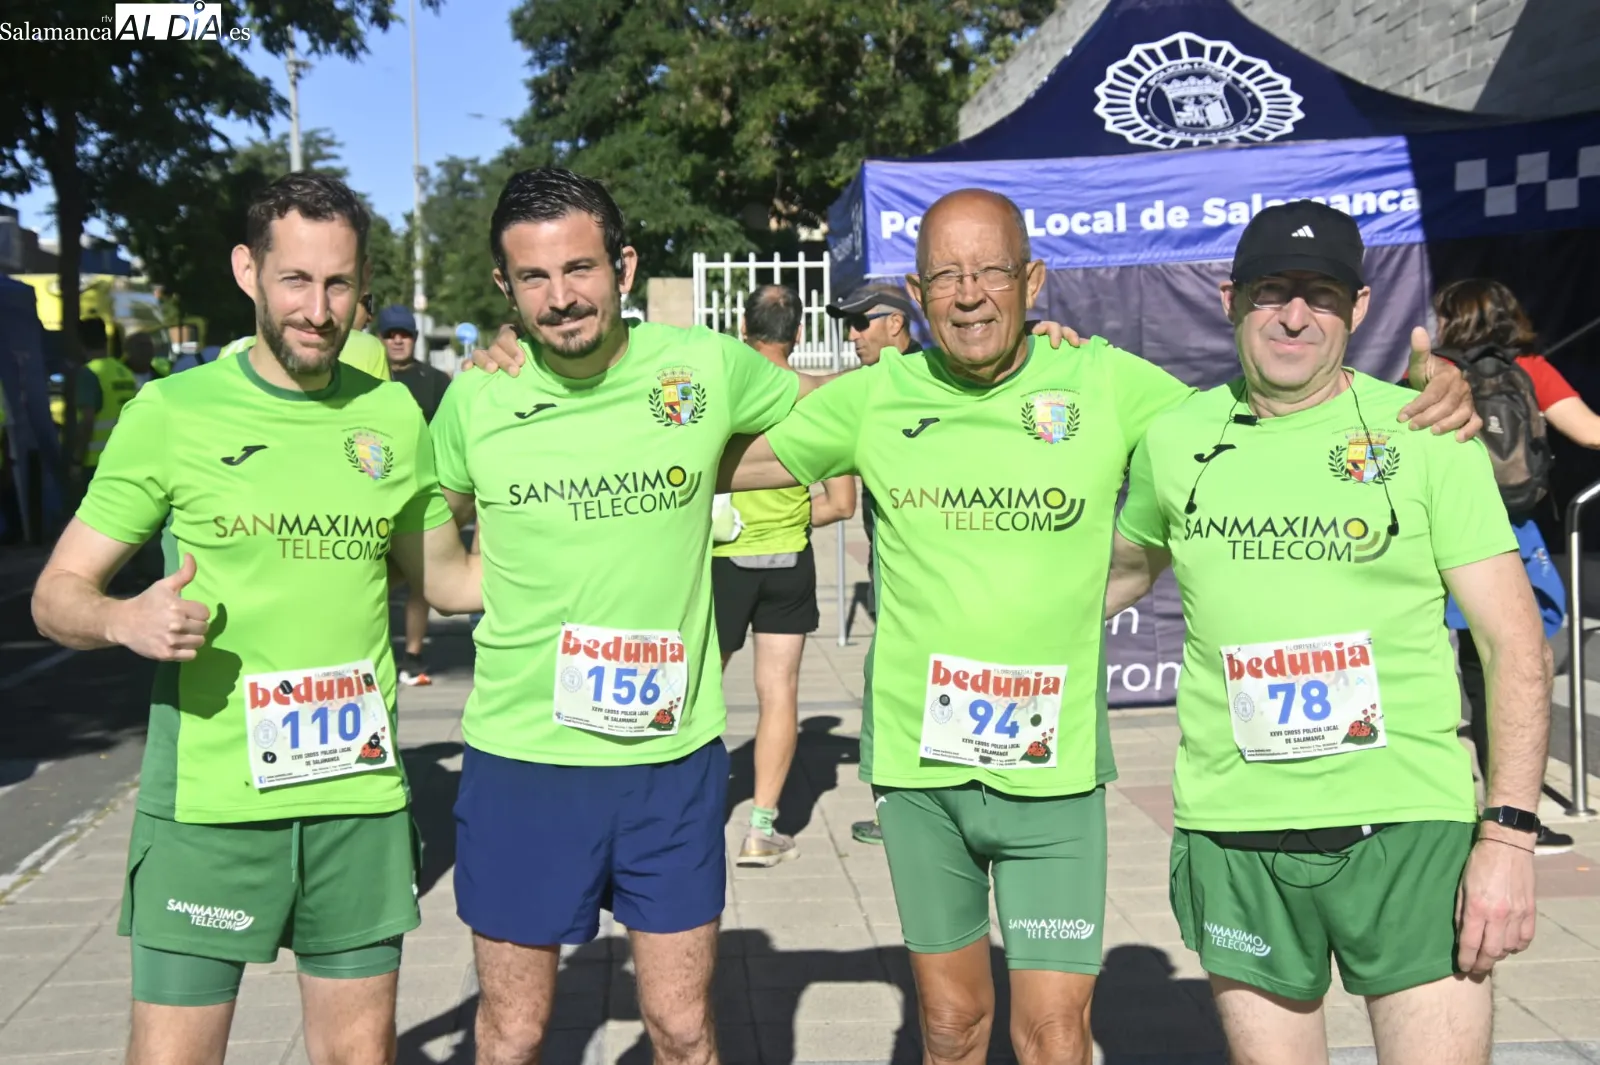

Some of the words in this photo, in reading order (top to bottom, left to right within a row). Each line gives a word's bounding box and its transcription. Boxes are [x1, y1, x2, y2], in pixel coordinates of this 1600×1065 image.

[881, 211, 919, 239] Po
[1024, 202, 1127, 237] Local
[1140, 200, 1189, 231] de
[509, 465, 687, 506] SANMAXIMO
[568, 490, 678, 521] TELECOM
[889, 487, 1067, 510] SANMAXIMO
[213, 513, 390, 539] SANMAXIMO
[940, 511, 1052, 532] TELECOM
[1184, 516, 1369, 540] SANMAXIMO
[277, 538, 379, 561] TELECOM
[1228, 540, 1352, 562] TELECOM
[561, 630, 685, 663] bedunia
[1226, 642, 1370, 681] bedunia
[587, 666, 660, 705] 156
[931, 660, 1061, 697] bedunia
[1267, 680, 1332, 725] 78
[282, 703, 361, 749] 110
[969, 699, 1020, 739] 94
[1284, 728, 1301, 736] CROSS
[1323, 724, 1339, 732] LOCAL
[1293, 734, 1325, 744] SALAMANCA
[312, 756, 340, 766] SALAMANCA
[981, 748, 1009, 756] SALAMANCA
[166, 898, 245, 921] SANMAXIMO
[190, 914, 237, 930] TELECOM
[1008, 919, 1087, 930] SANMAXIMO
[1204, 921, 1263, 947] NMAXIMO
[1210, 934, 1256, 955] TELECOM
